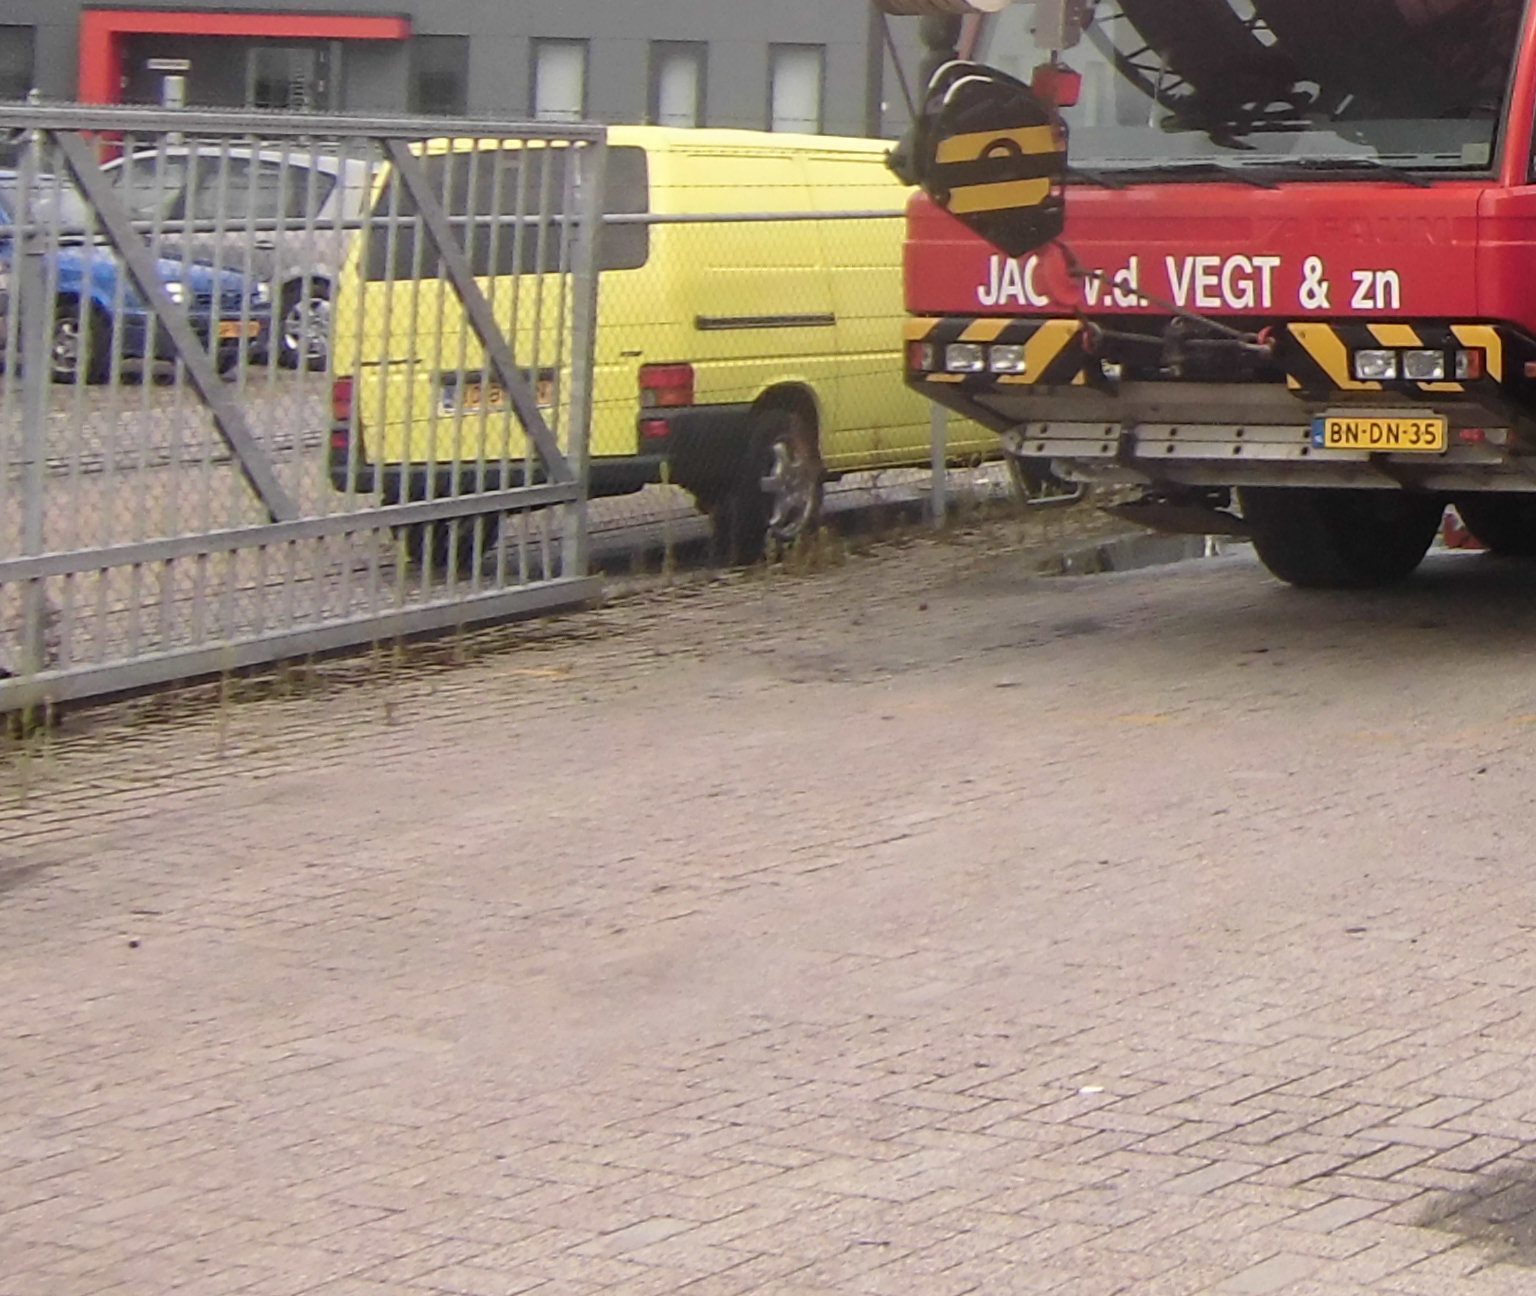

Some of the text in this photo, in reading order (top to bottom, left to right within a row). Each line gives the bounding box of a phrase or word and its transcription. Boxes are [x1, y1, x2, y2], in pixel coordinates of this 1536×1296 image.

[1084, 255, 1149, 307] v.d.
[1166, 255, 1281, 309] VEGT
[1299, 255, 1331, 309] &
[1351, 269, 1400, 309] zn
[1330, 422, 1437, 445] BN-DN-35
